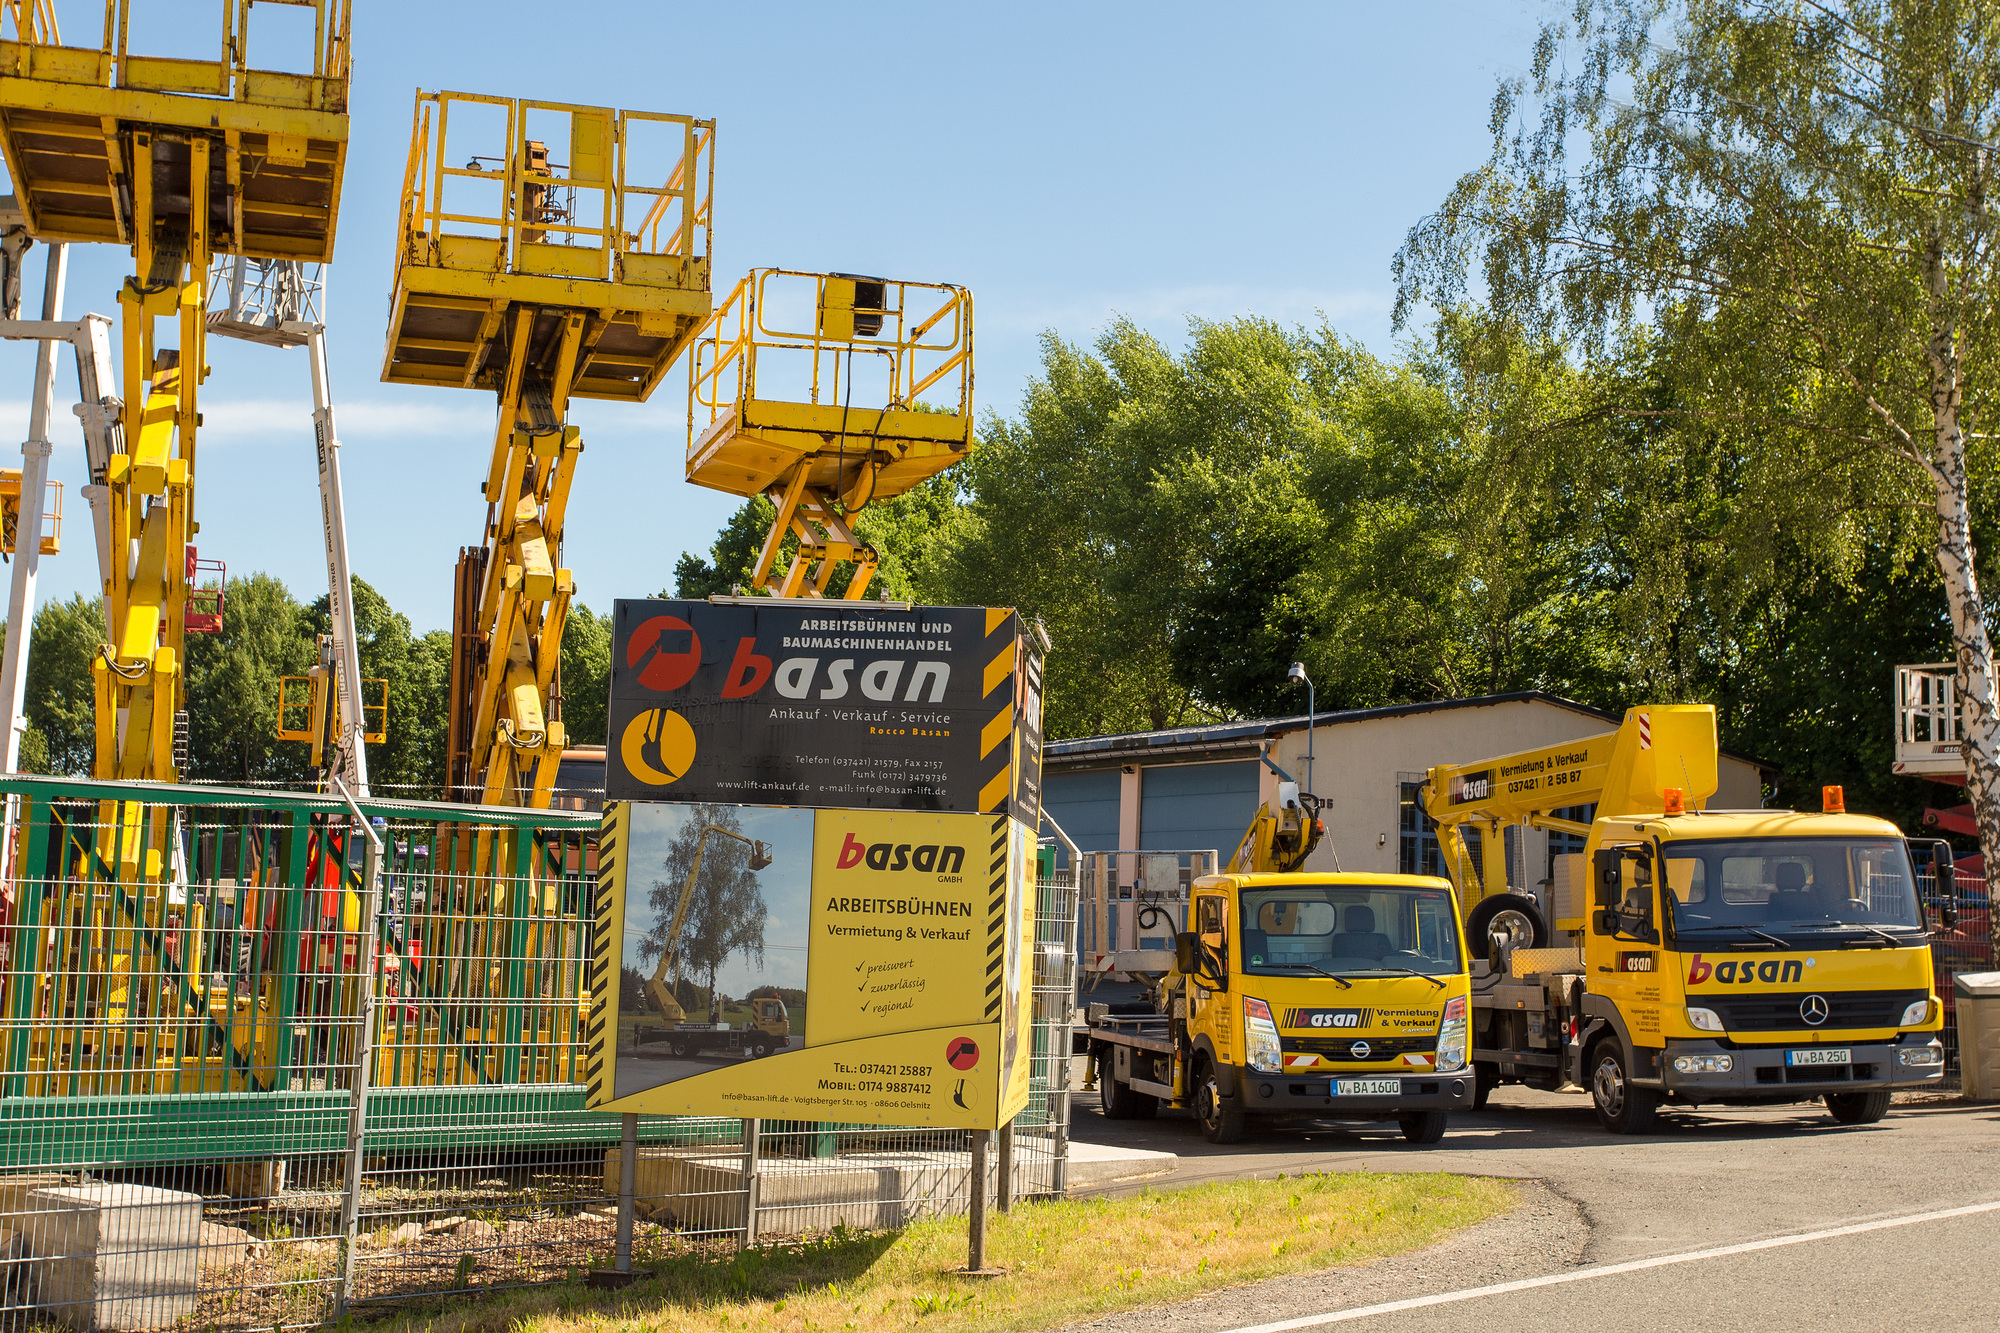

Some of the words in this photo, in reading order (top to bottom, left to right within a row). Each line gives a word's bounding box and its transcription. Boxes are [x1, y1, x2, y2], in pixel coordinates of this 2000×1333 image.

[800, 617, 916, 633] ARBEITSBÜHNEN
[921, 623, 952, 634] UND
[782, 636, 952, 652] BAUMASCHINENHANDEL
[720, 637, 951, 703] basan
[769, 708, 820, 720] Ankauf
[833, 710, 888, 722] Verkauf
[900, 711, 951, 724] Service
[870, 726, 905, 735] Rocco
[912, 728, 950, 737] Basan
[795, 755, 830, 764] Telefon
[833, 757, 871, 767] (037421)
[874, 758, 902, 768] 21579,
[905, 759, 921, 767] Fax
[924, 760, 943, 769] 2157
[1500, 760, 1544, 778] Vermietung
[1547, 757, 1553, 768] &
[1555, 750, 1588, 767] Verkauf
[852, 771, 876, 779] Funk
[878, 772, 906, 782] (0172)
[909, 773, 947, 783] 3479736
[1508, 777, 1539, 793] 037421
[1547, 774, 1554, 787] 2
[1556, 772, 1567, 786] 58
[1570, 770, 1582, 783] 87
[717, 780, 810, 791] www.lift-ankauf.de
[819, 784, 853, 793] e-mail:
[856, 785, 947, 796] info@basan-lift.de
[836, 832, 965, 873] basan
[937, 875, 963, 884] GMBH
[827, 896, 972, 917] ARBEITSBÜHNEN
[827, 924, 903, 941] Vermietung
[906, 927, 917, 939] &
[920, 928, 971, 941] Verkauf
[866, 959, 915, 979] preiswert
[1622, 953, 1651, 972] basan
[1687, 953, 1803, 985] basan
[870, 976, 926, 993] zuverlässig
[872, 997, 914, 1018] regional
[1376, 1009, 1440, 1018] Vermietung
[1295, 1010, 1358, 1027] basan
[1381, 1019, 1390, 1027] &
[1393, 1019, 1436, 1027] Verkauf
[1796, 1052, 1804, 1063] V
[1810, 1052, 1825, 1063] BA
[1827, 1051, 1847, 1062] 250
[859, 1063, 897, 1075] 037421
[899, 1065, 932, 1077] 25887
[858, 1081, 883, 1092] 0174
[886, 1082, 931, 1094] 9887412
[1338, 1081, 1346, 1094] V
[1353, 1081, 1369, 1094] BA
[1371, 1081, 1399, 1094] 1600
[721, 1092, 789, 1103] info@basan-lift.de
[794, 1095, 841, 1107] Voigtsberger
[842, 1098, 854, 1106] Str.
[855, 1100, 868, 1108] 105
[874, 1099, 899, 1108] 08606
[900, 1100, 931, 1109] Oelsnitz
